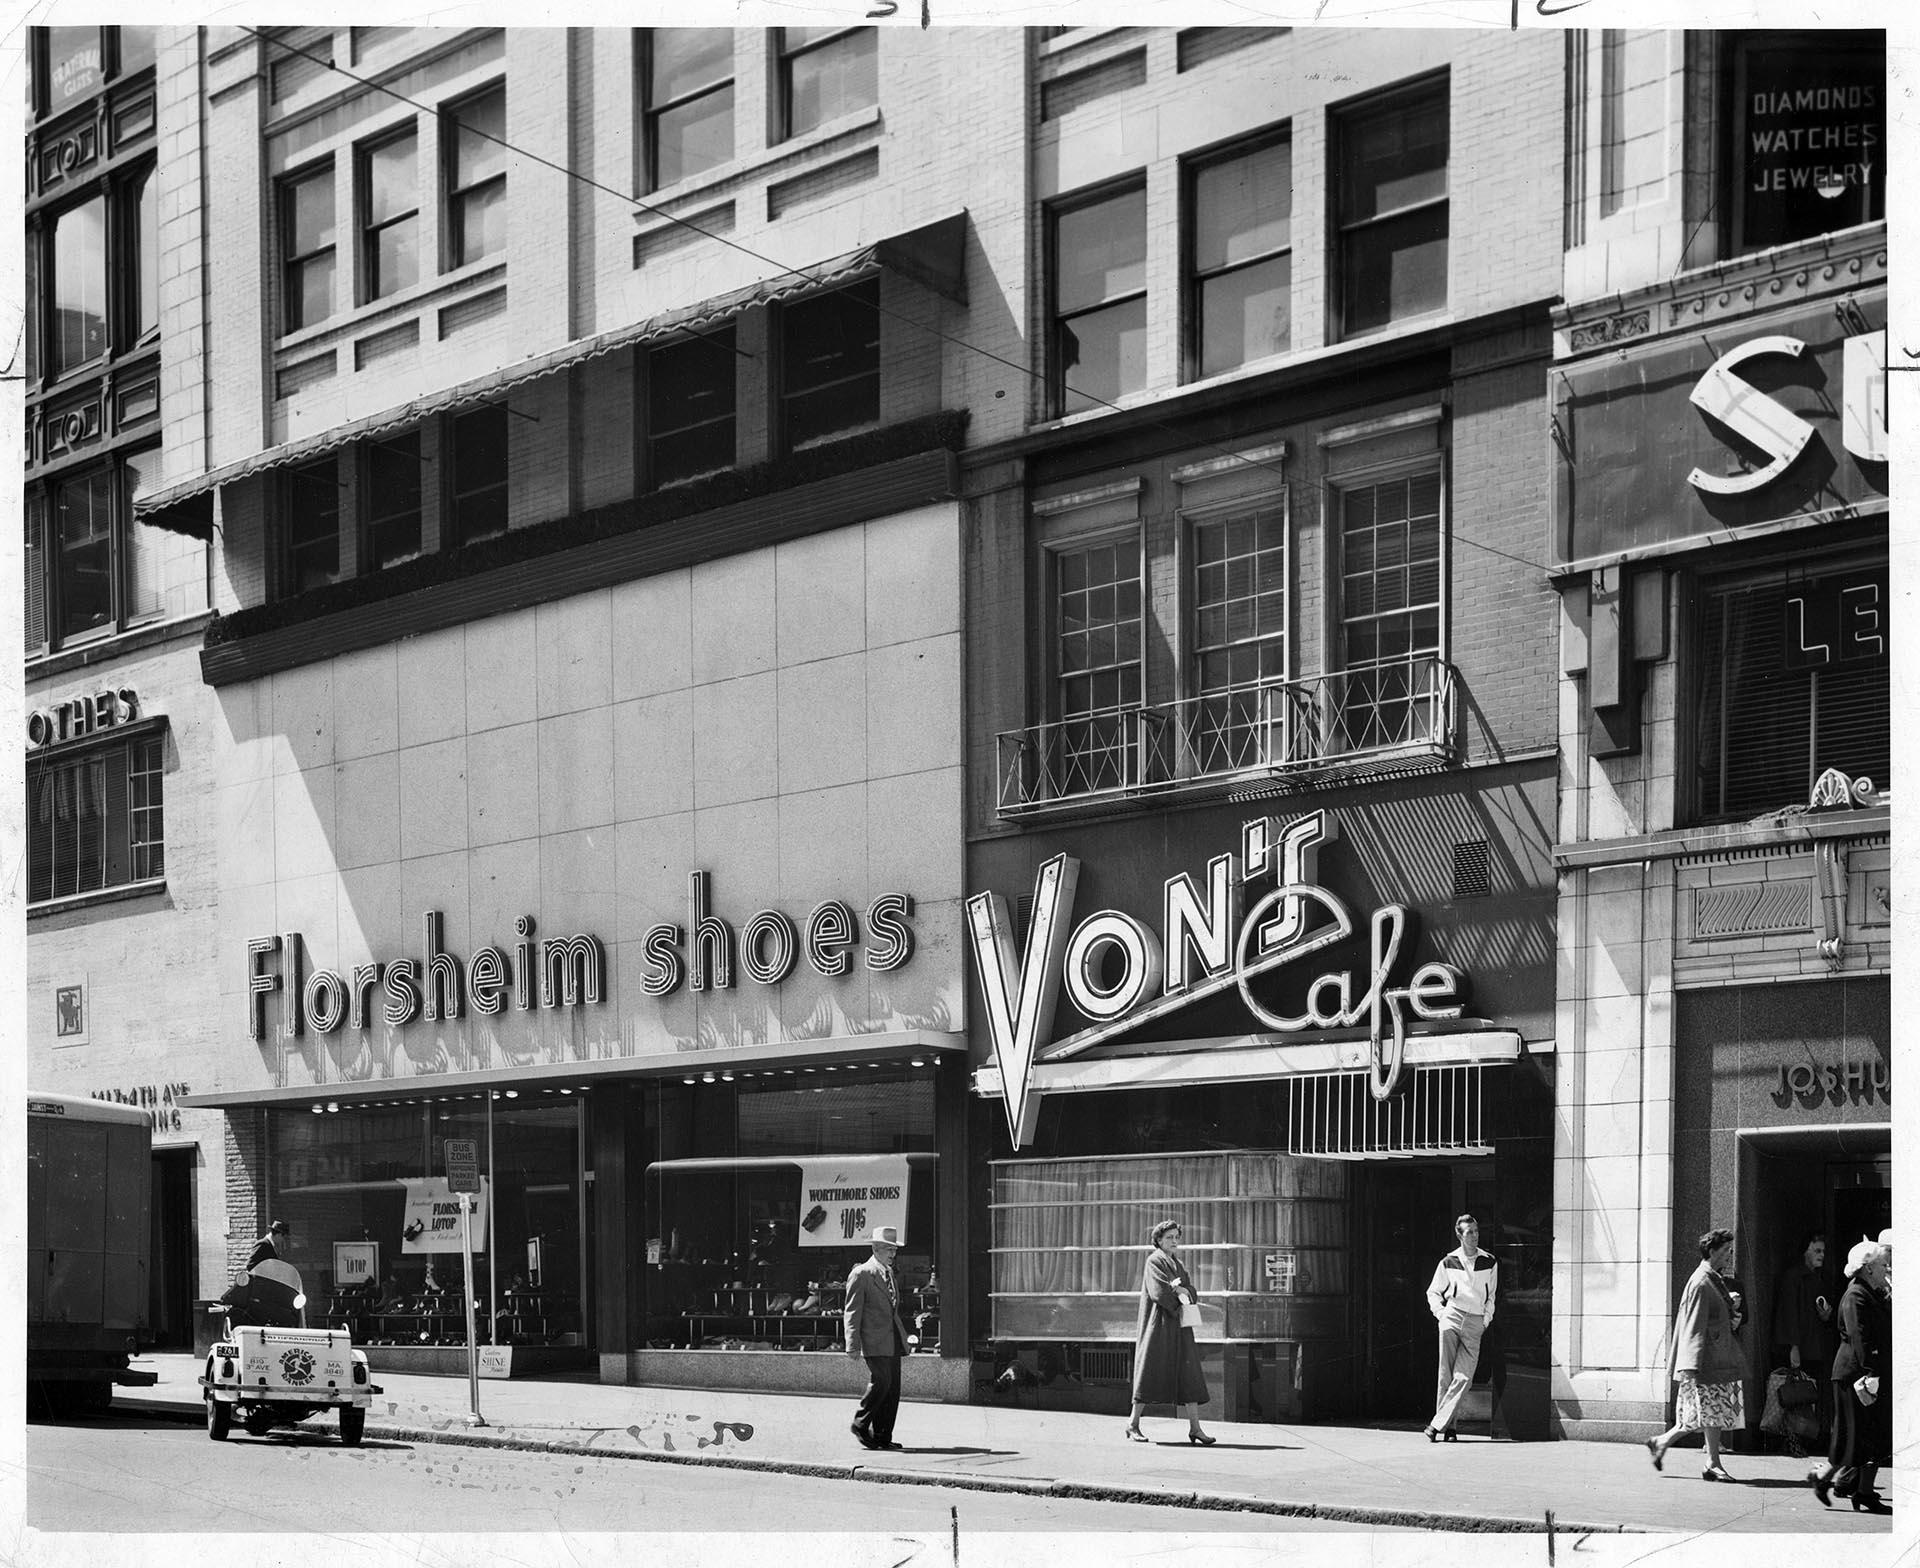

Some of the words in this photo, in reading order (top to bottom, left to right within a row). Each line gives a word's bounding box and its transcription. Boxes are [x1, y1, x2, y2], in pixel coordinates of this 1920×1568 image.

[1754, 85, 1875, 114] DIAMONDS
[1752, 123, 1878, 153] WATCHES
[1754, 163, 1872, 192] JEWELRY
[246, 911, 606, 1040] Florsheim
[640, 870, 914, 996] shoes
[967, 809, 1332, 1151] VON'S
[1236, 883, 1466, 1101] Cafe
[163, 1083, 190, 1106] AVE
[450, 1152, 474, 1161] ZONE
[452, 1143, 470, 1152] BUS
[809, 1187, 868, 1202] WORTHMORE
[870, 1186, 900, 1200] SHOES
[432, 1217, 457, 1232] LOTOP
[278, 1348, 317, 1366] AMERICAN
[481, 1356, 506, 1367] SHINE
